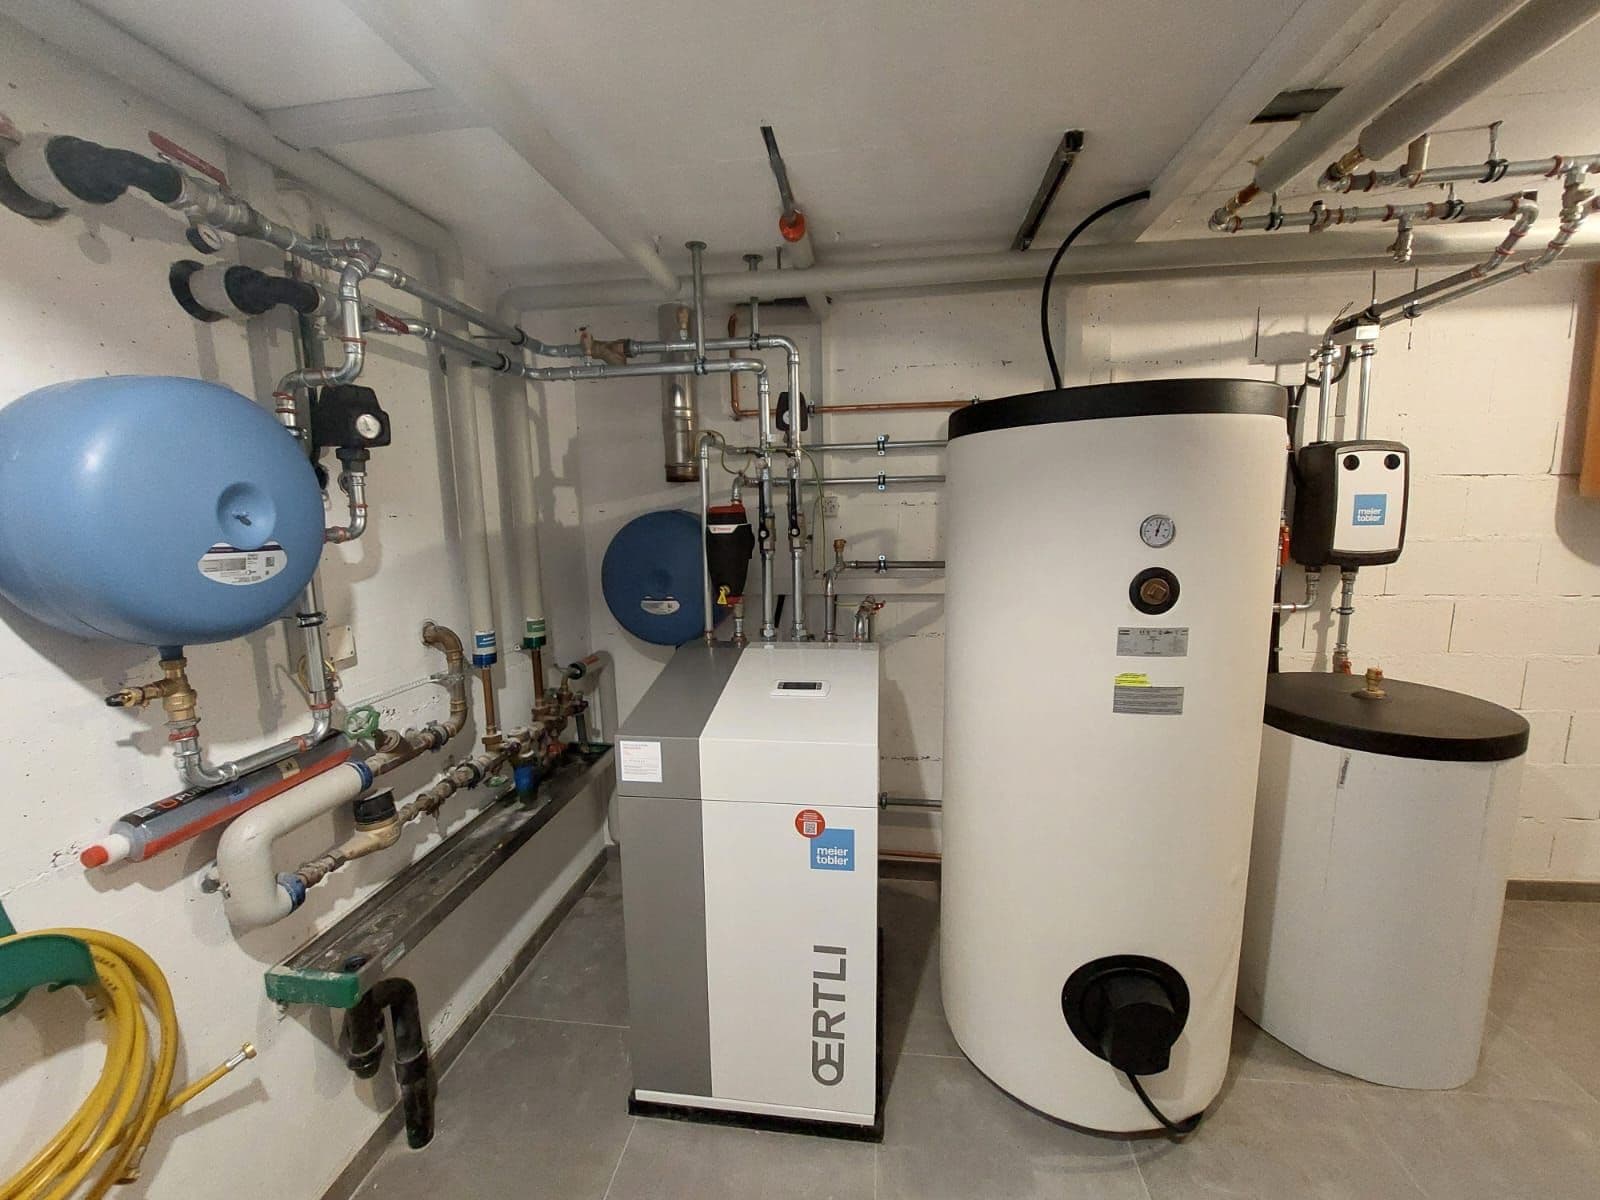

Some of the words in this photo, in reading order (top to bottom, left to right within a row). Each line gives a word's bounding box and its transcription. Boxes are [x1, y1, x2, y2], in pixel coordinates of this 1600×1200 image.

[1358, 507, 1382, 517] meier
[816, 846, 849, 856] meier
[815, 855, 849, 865] tobler
